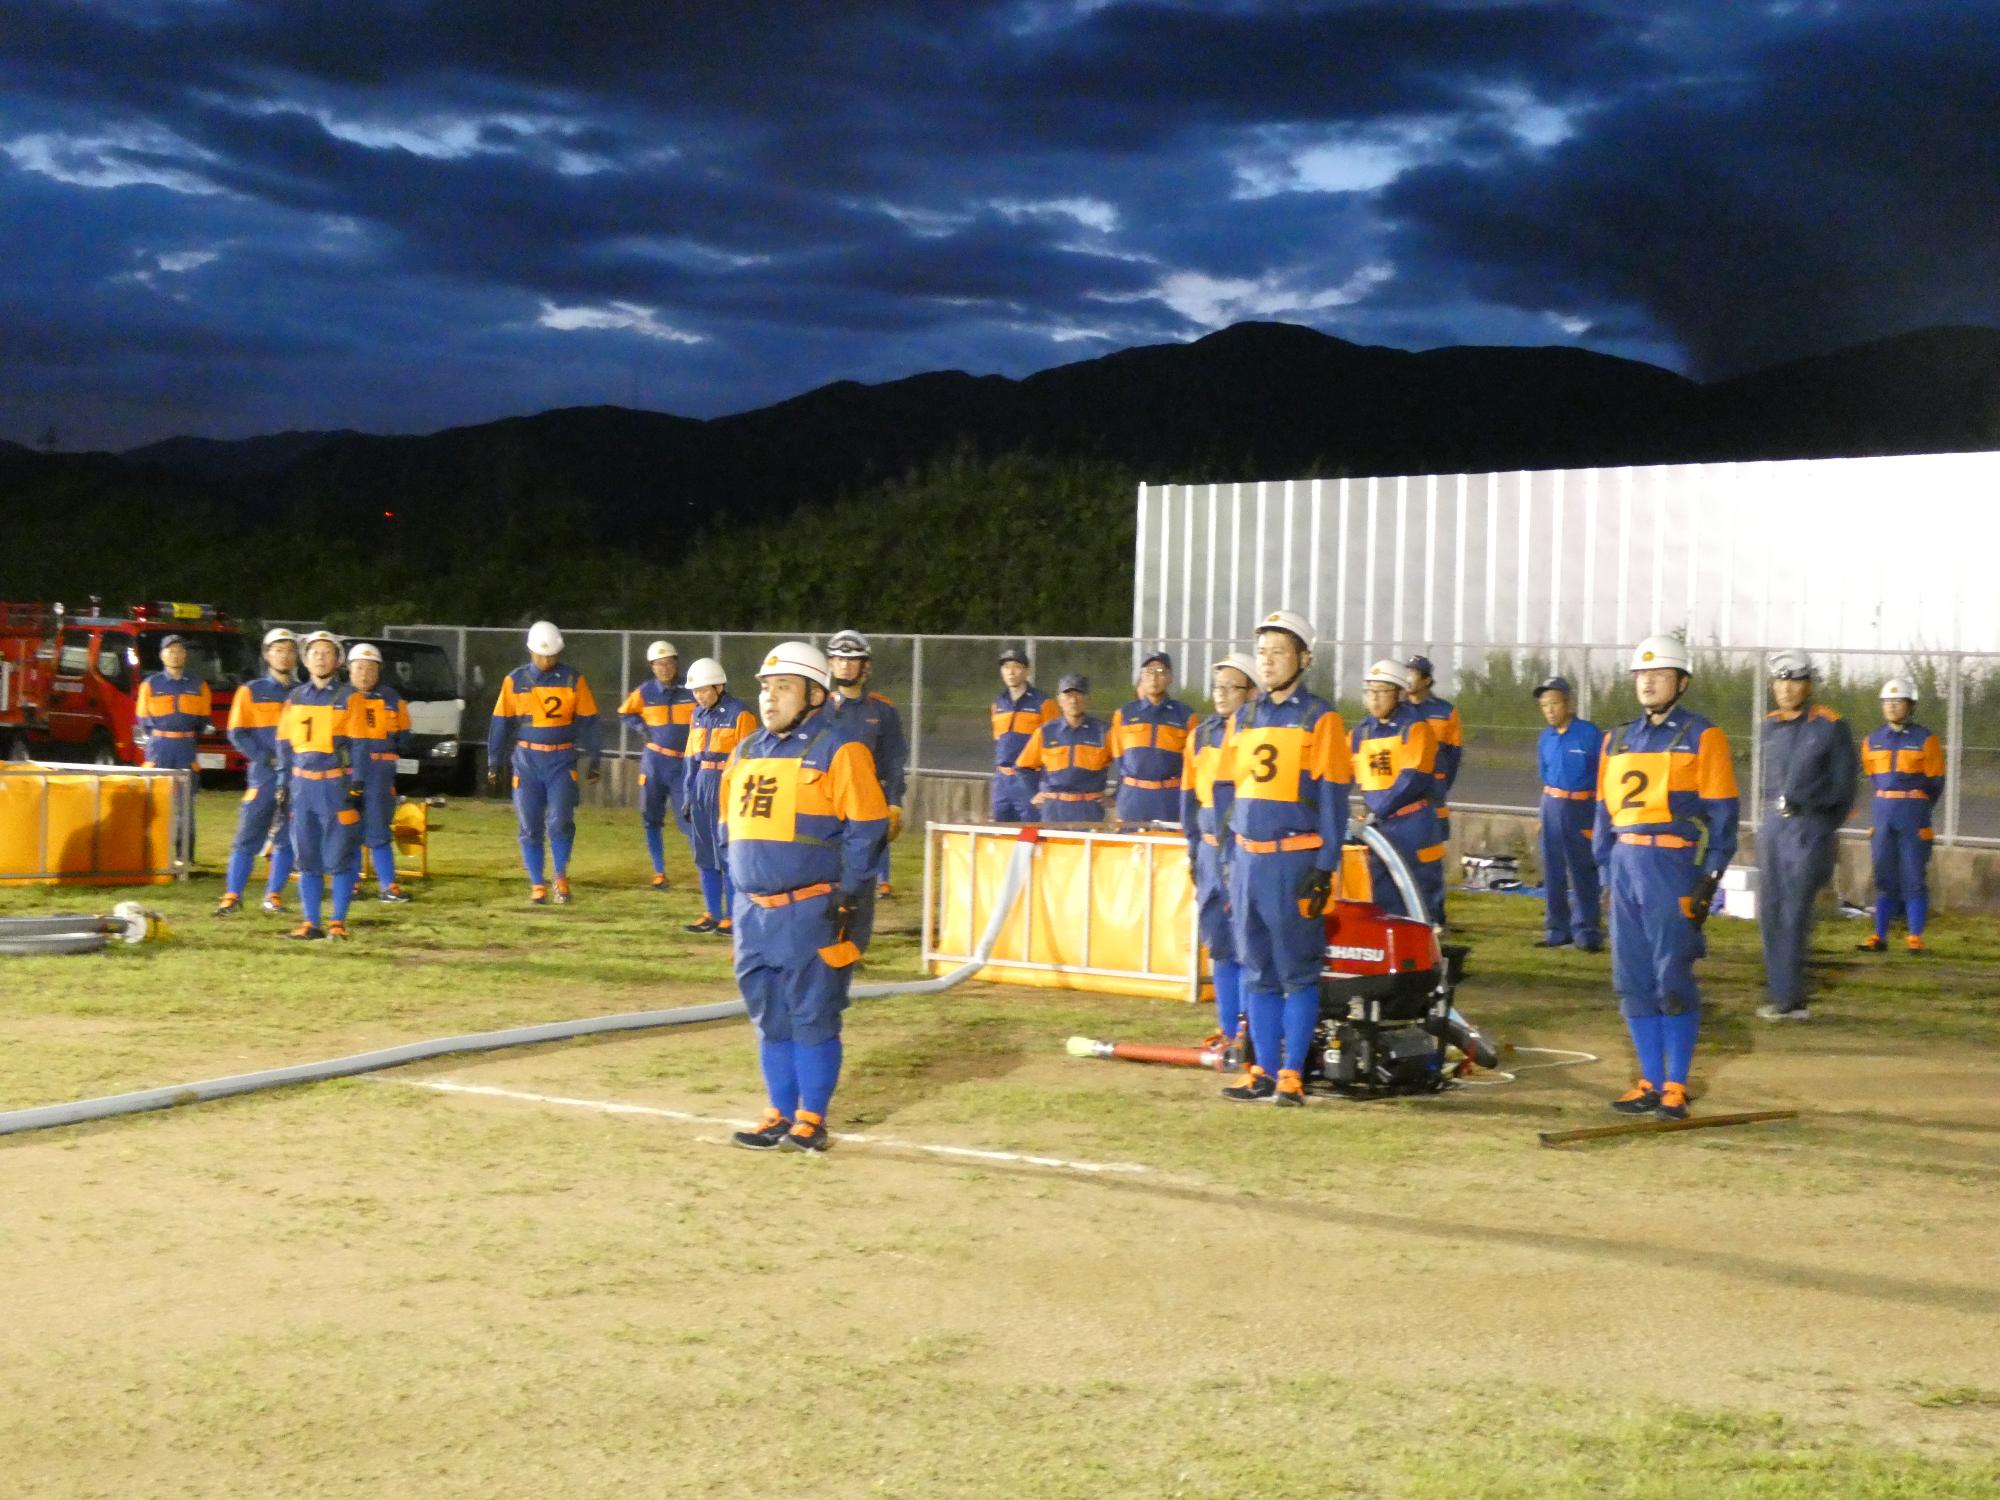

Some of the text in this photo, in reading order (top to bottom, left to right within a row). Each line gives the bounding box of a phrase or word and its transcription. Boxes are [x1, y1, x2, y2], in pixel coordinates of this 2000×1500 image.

[544, 695, 562, 718] 2
[301, 716, 313, 742] 1
[1250, 743, 1278, 783] 3
[739, 774, 777, 819] 指
[1620, 769, 1649, 809] 2
[1325, 945, 1385, 962] OHATSU
